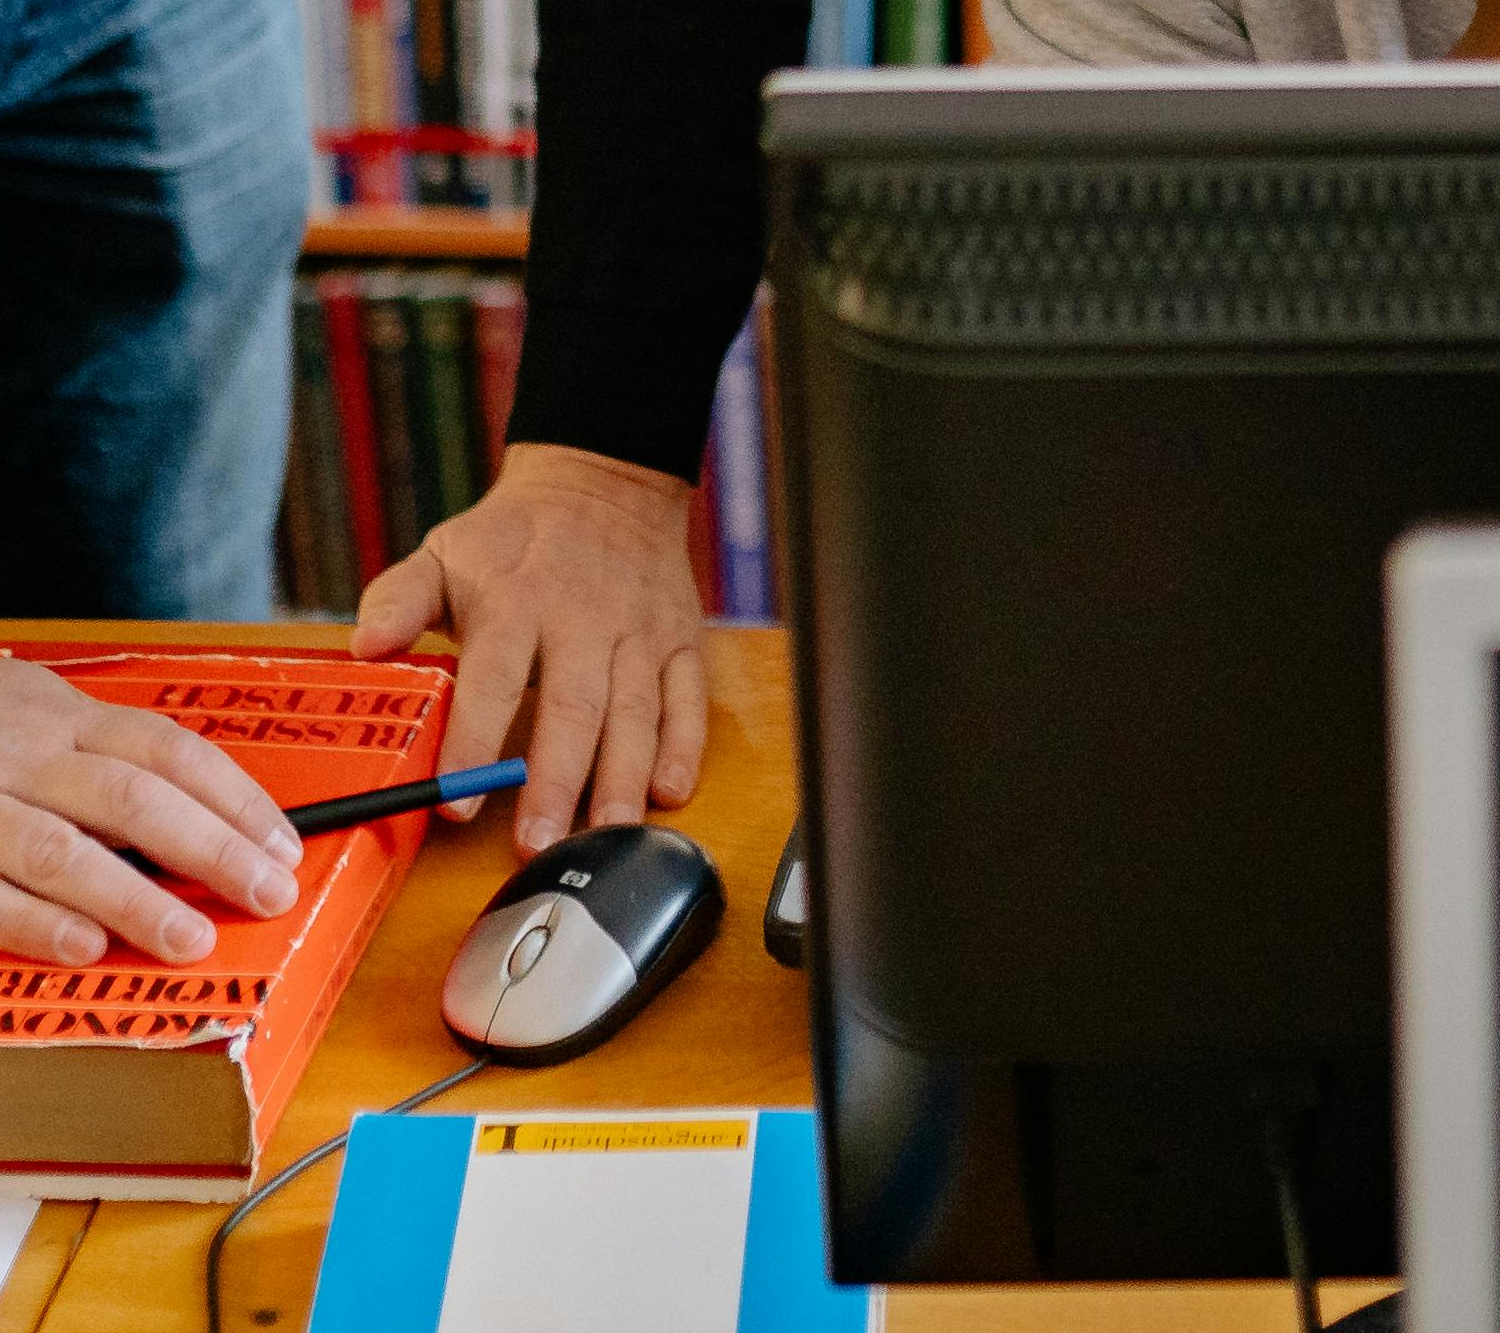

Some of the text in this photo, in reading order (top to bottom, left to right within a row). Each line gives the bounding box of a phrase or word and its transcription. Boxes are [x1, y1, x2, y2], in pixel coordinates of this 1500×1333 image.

[150, 685, 431, 716] DEUTSCH
[166, 715, 412, 747] RUSSISC
[542, 1131, 743, 1153] Langenscheidt
